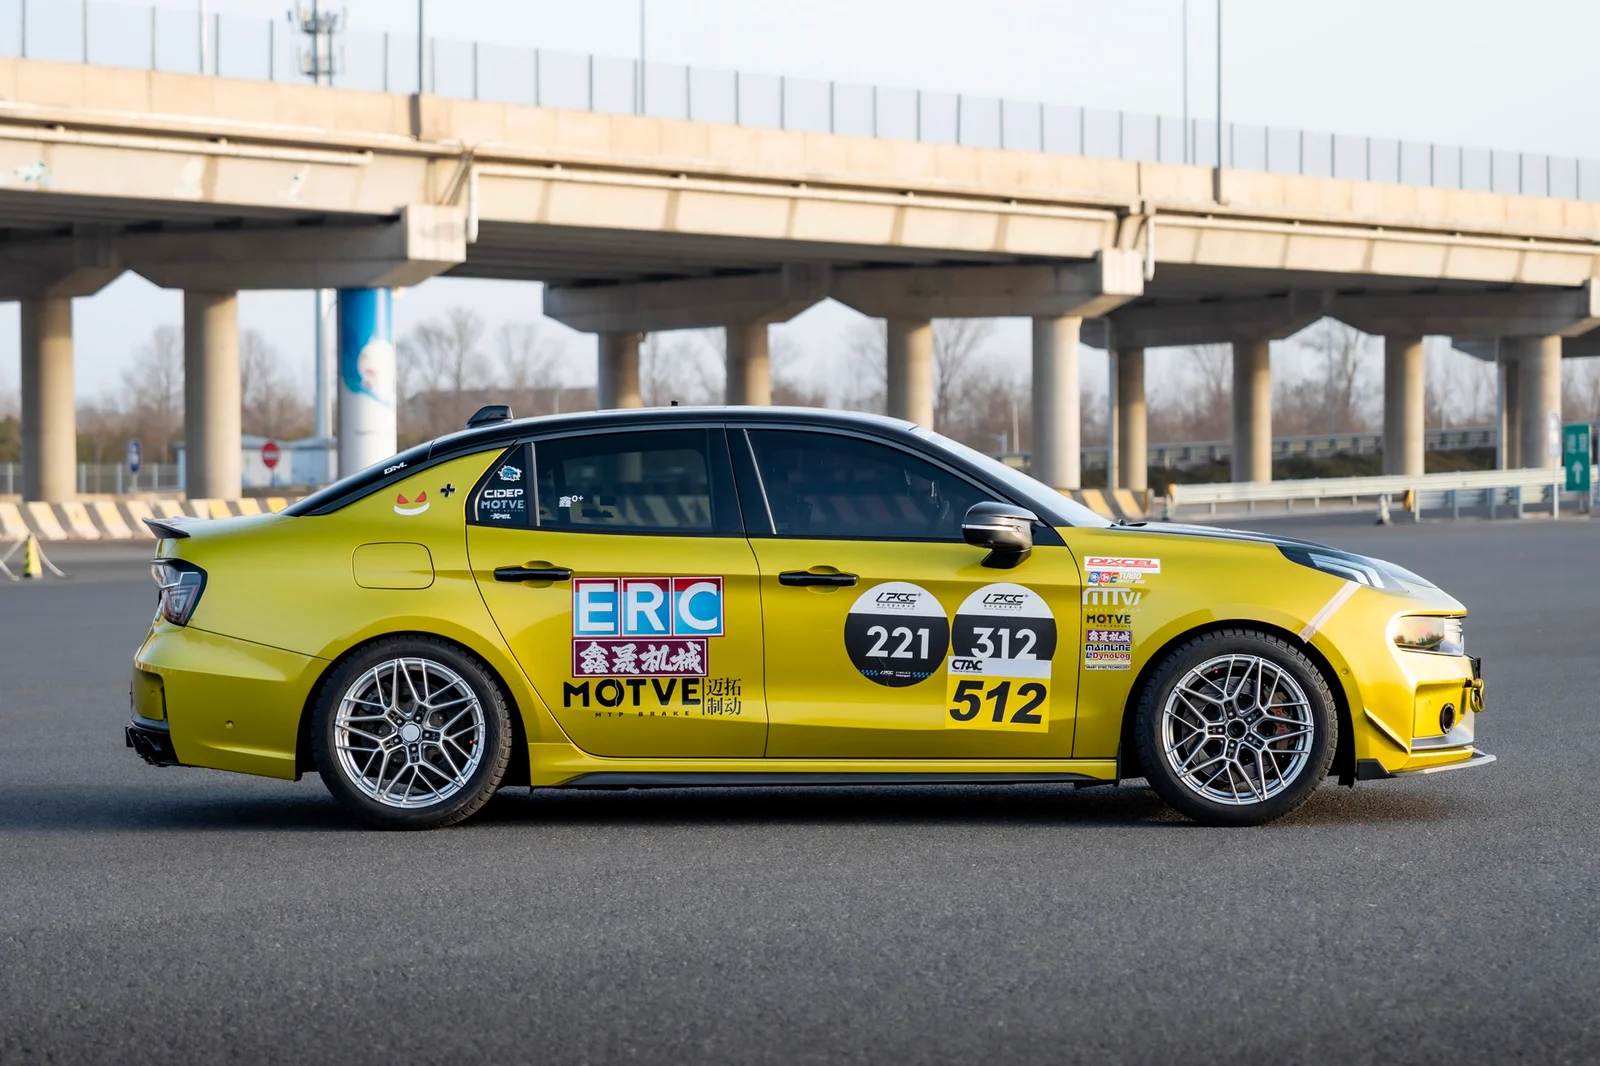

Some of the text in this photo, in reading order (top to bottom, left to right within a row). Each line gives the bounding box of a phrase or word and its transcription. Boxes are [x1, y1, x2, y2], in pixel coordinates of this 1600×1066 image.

[484, 488, 524, 499] CIDEP
[481, 499, 525, 509] MOTVE
[1087, 557, 1158, 569] DIXCEL
[578, 581, 718, 632] ERC
[1086, 613, 1132, 624] MOTVE
[865, 625, 930, 660] 221
[970, 627, 1037, 660] 312
[579, 641, 704, 675] 鑫晟机械
[952, 658, 983, 671] CTAC
[563, 678, 701, 708] MOTVE
[706, 677, 741, 697] 迈拓
[706, 697, 741, 716] 制动
[949, 680, 1048, 724] 512
